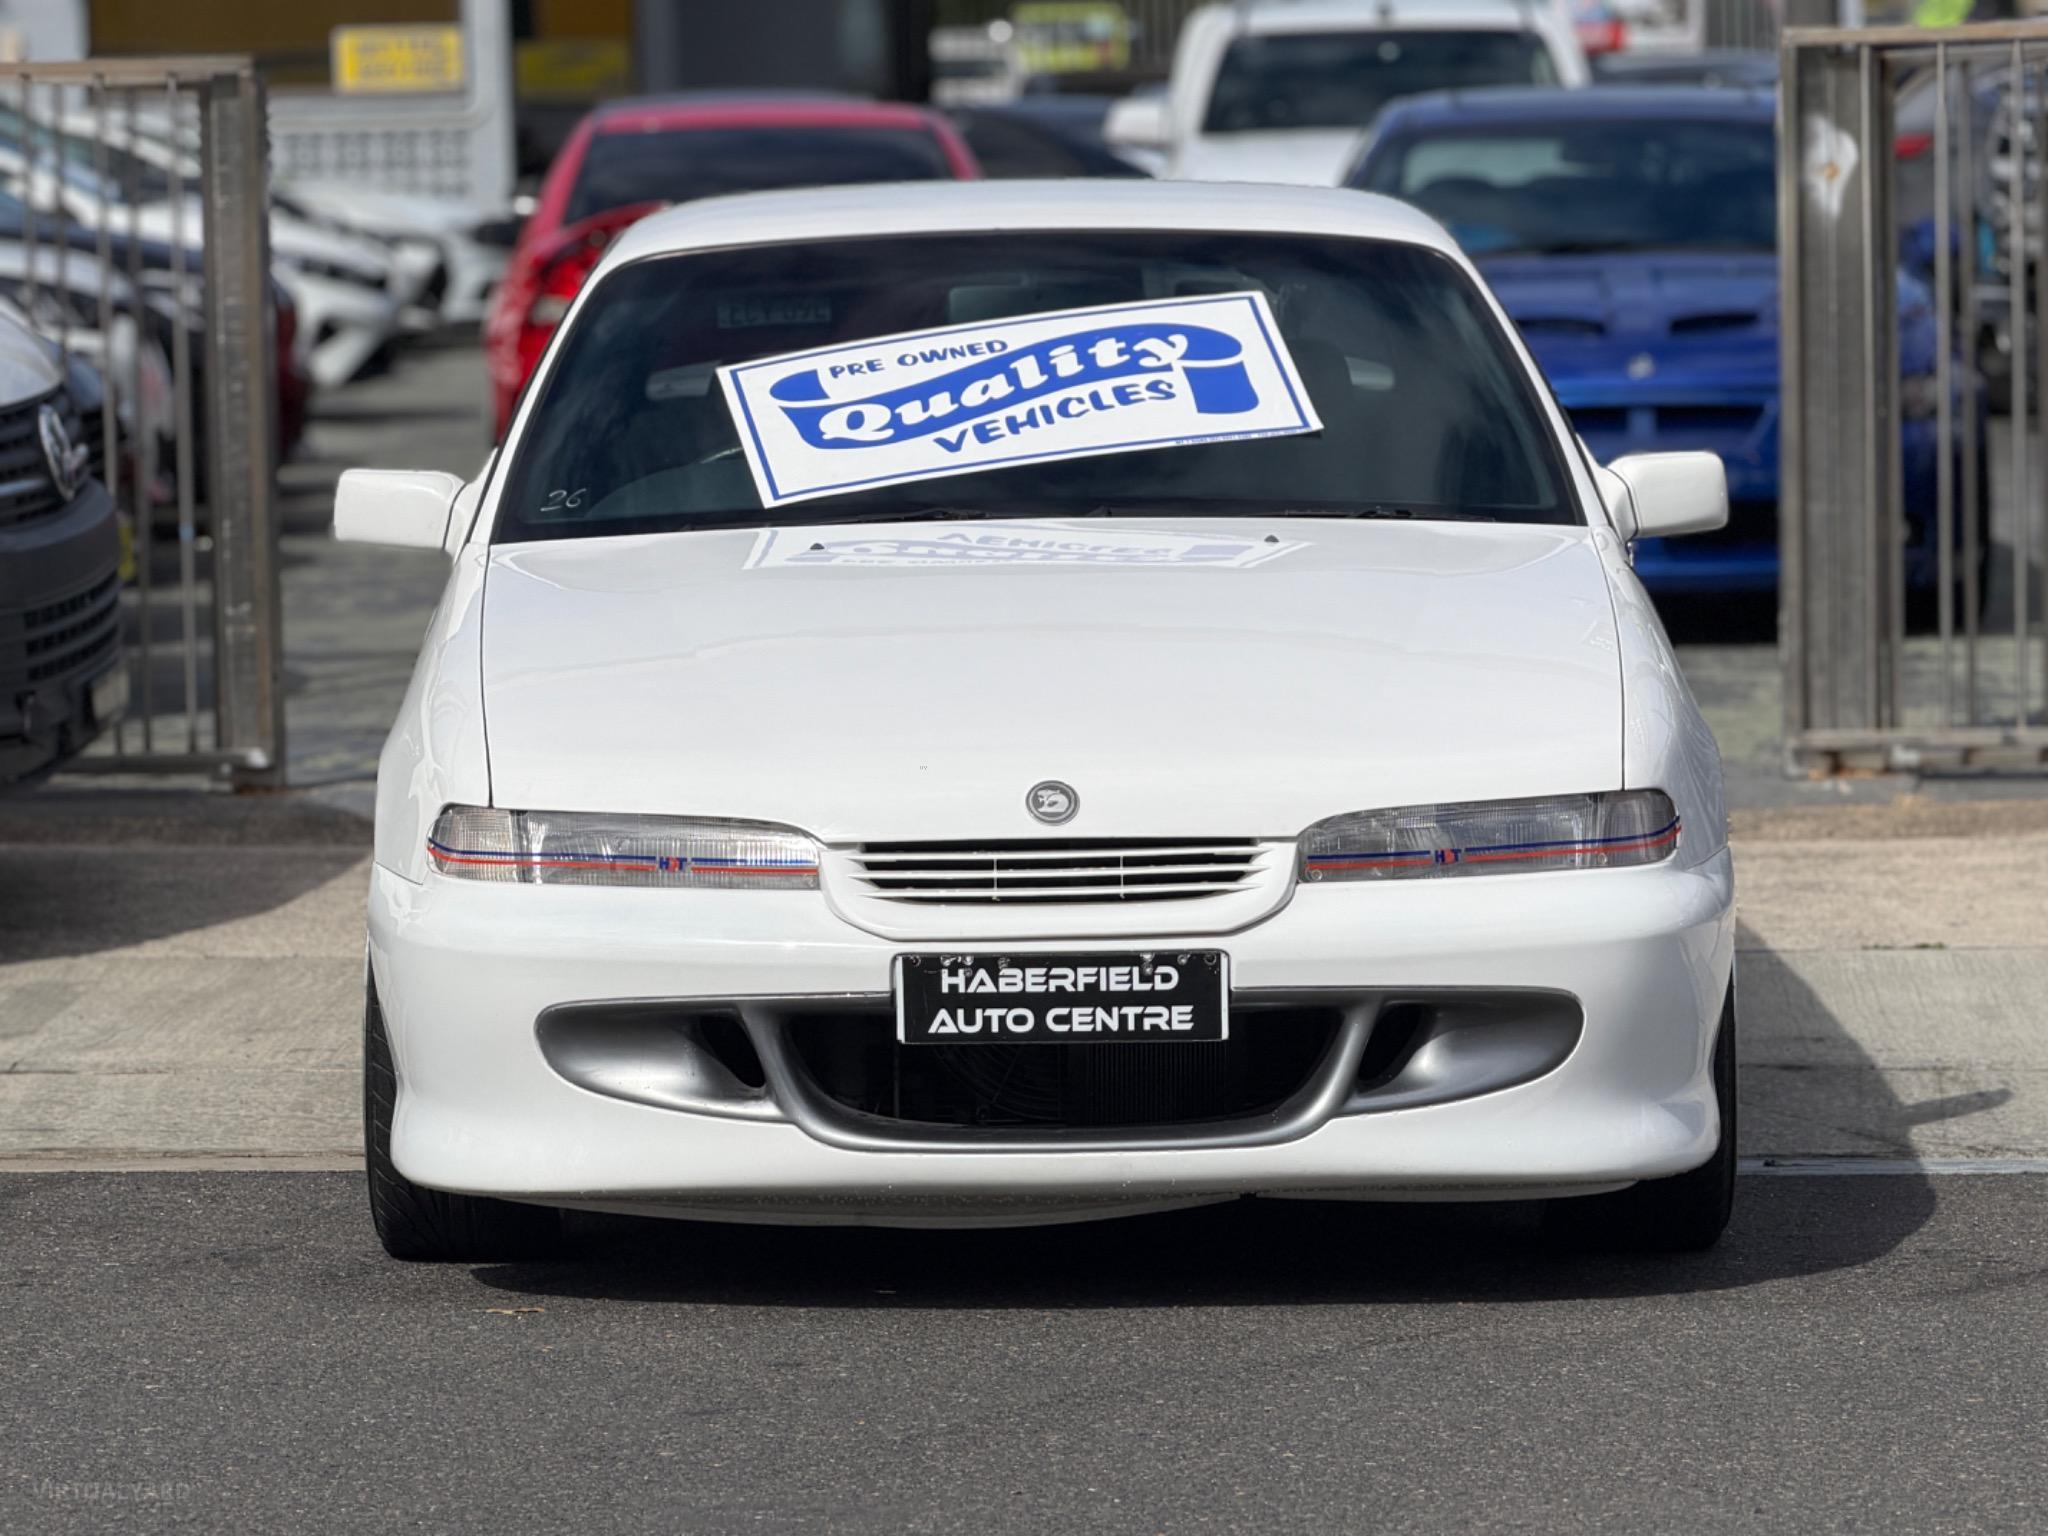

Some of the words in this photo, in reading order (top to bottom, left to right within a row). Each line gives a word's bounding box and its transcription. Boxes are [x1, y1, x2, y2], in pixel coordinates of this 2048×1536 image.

[829, 358, 885, 379] PRE
[897, 339, 1008, 367] OWNED
[820, 333, 1189, 442] Quality
[934, 379, 1175, 453] VEHICLES
[941, 966, 1179, 993] HABERFIELD
[928, 1007, 1035, 1033] AUTO
[1046, 1005, 1194, 1033] CENTRE
